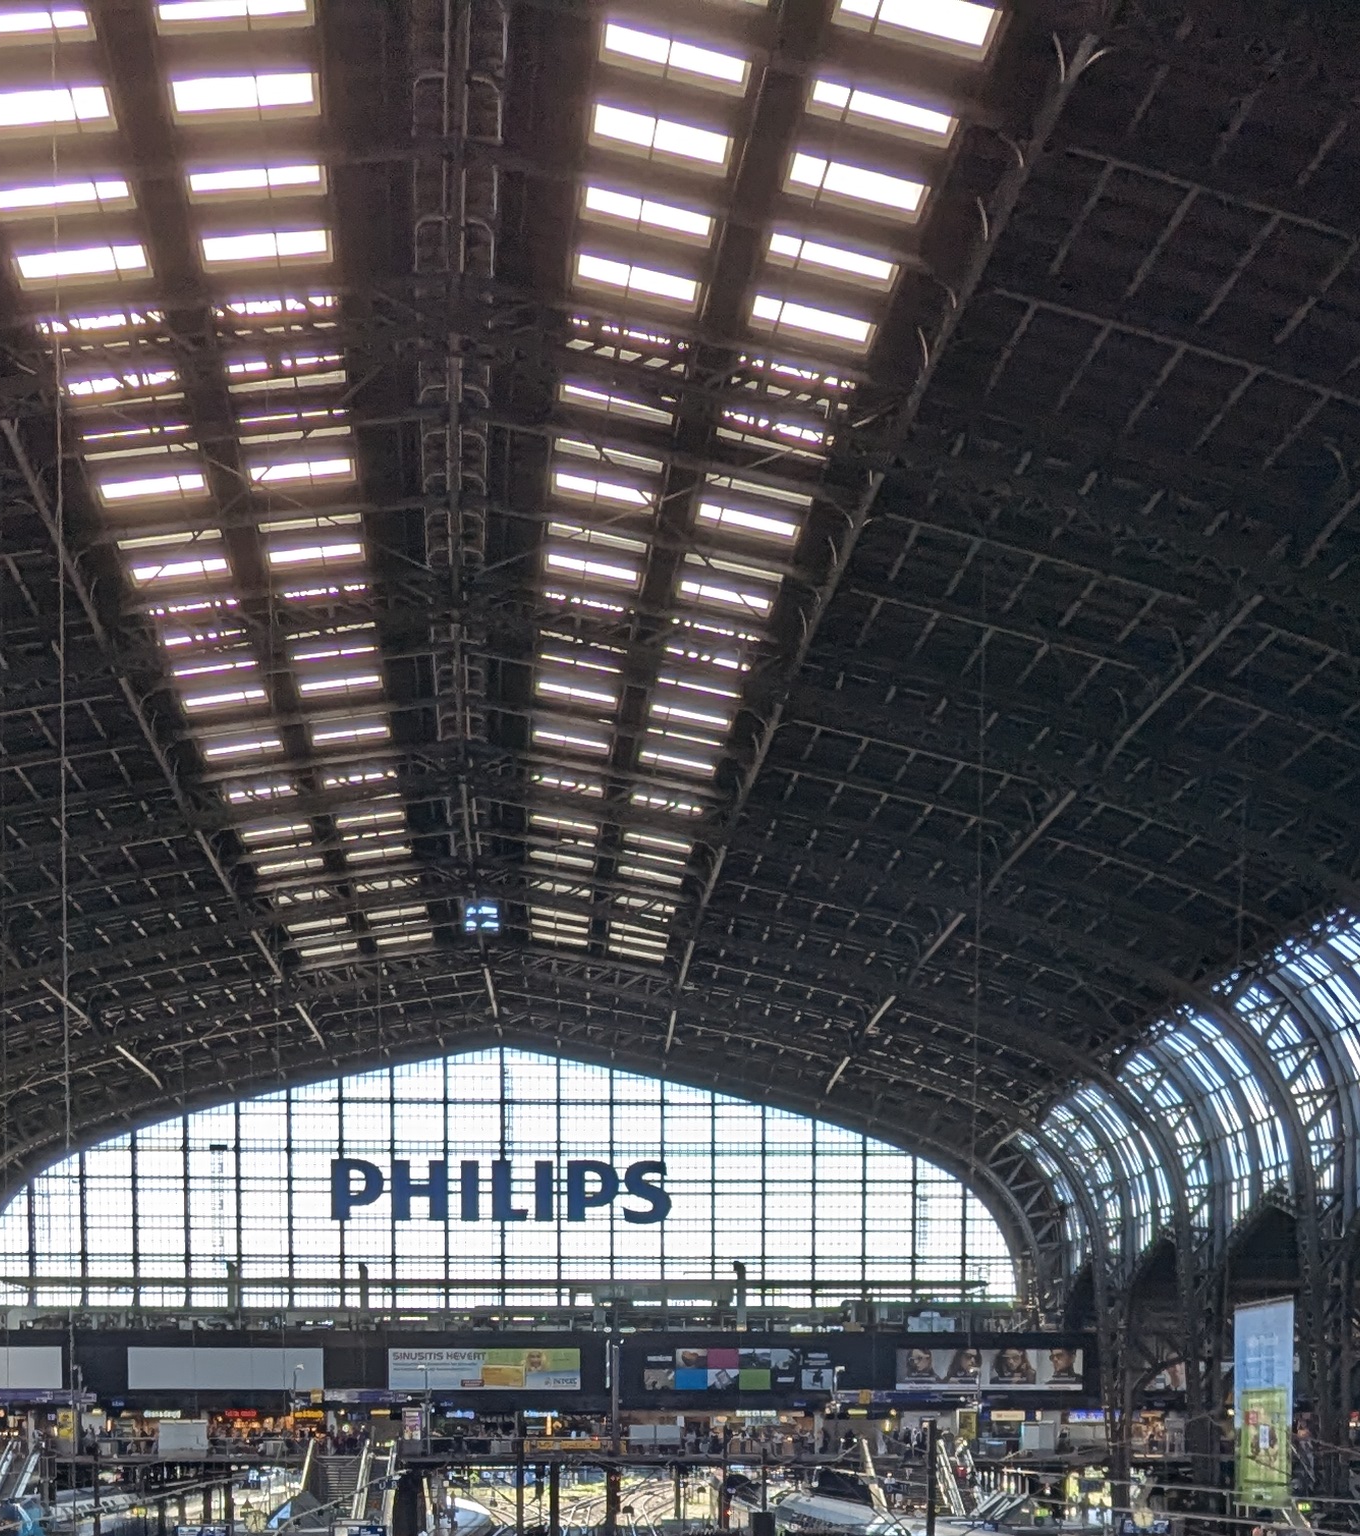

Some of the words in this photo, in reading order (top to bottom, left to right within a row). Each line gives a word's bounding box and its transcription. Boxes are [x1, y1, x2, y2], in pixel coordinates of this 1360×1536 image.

[331, 1158, 672, 1225] PHILIPS
[393, 1351, 443, 1361] SINUSITIS
[446, 1351, 486, 1361] HEVERT
